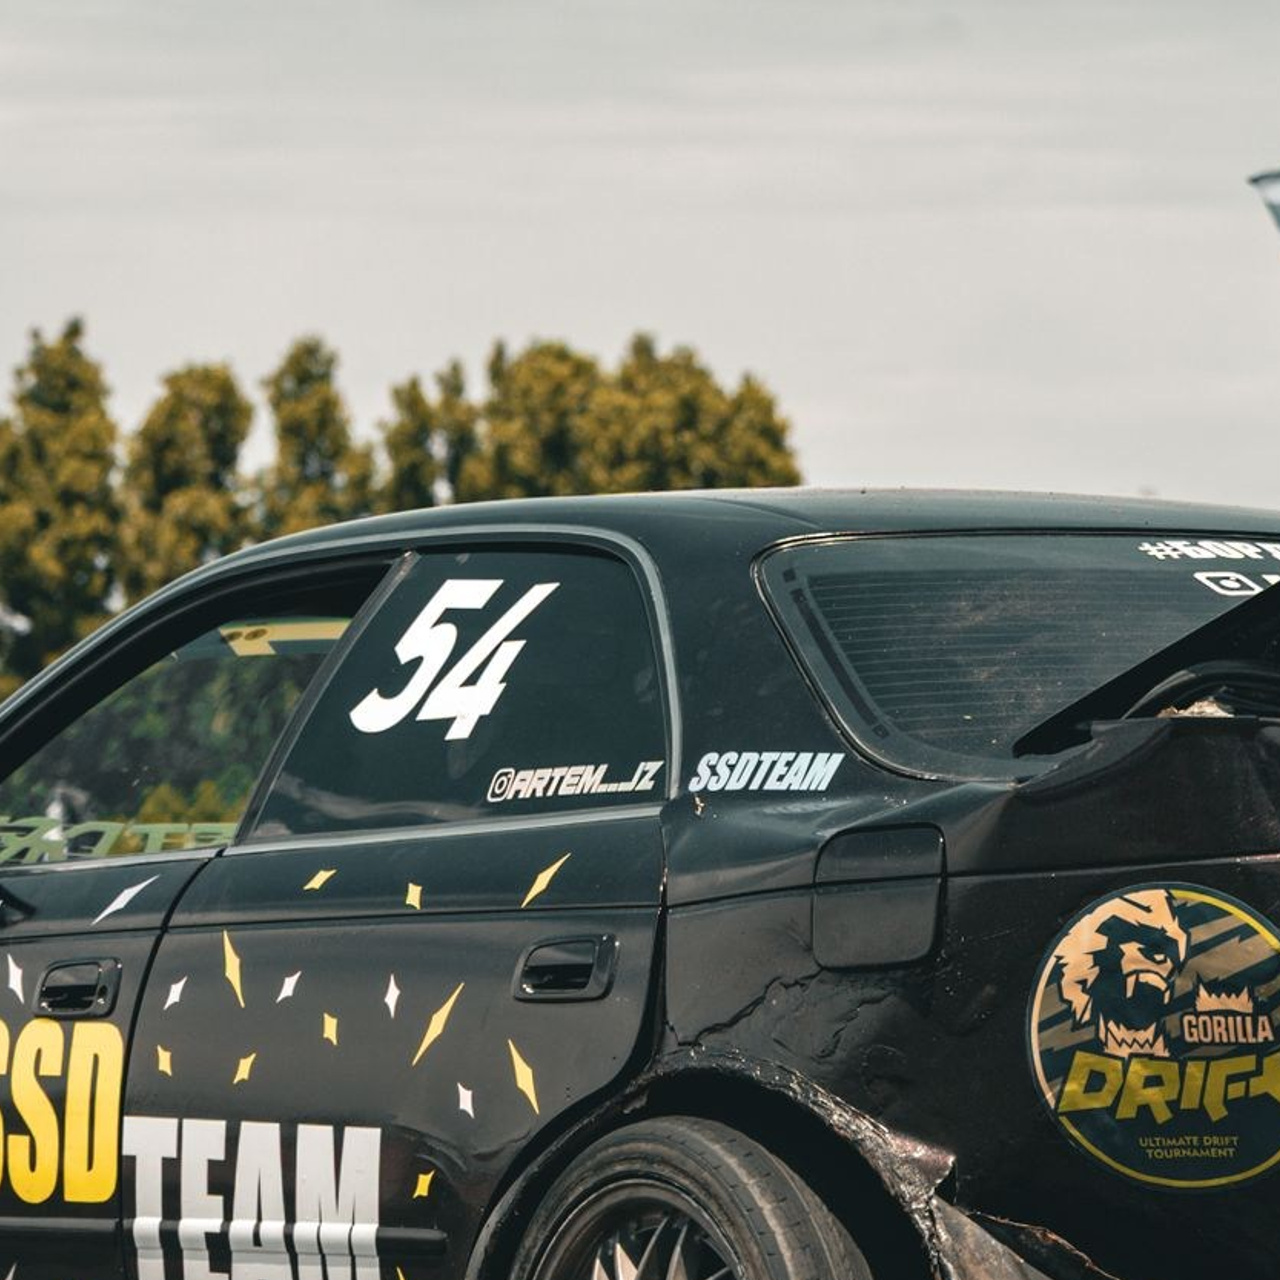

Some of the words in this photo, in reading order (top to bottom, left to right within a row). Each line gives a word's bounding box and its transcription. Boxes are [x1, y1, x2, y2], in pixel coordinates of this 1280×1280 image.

[350, 579, 560, 740] 54
[688, 752, 845, 792] SSDTEAM
[1182, 1014, 1274, 1044] GORILLA
[0, 1018, 124, 1203] SD
[1139, 1136, 1200, 1147] ULTIMATE
[1202, 1135, 1239, 1147] DRIFT
[1146, 1147, 1236, 1159] TOURNAMENT
